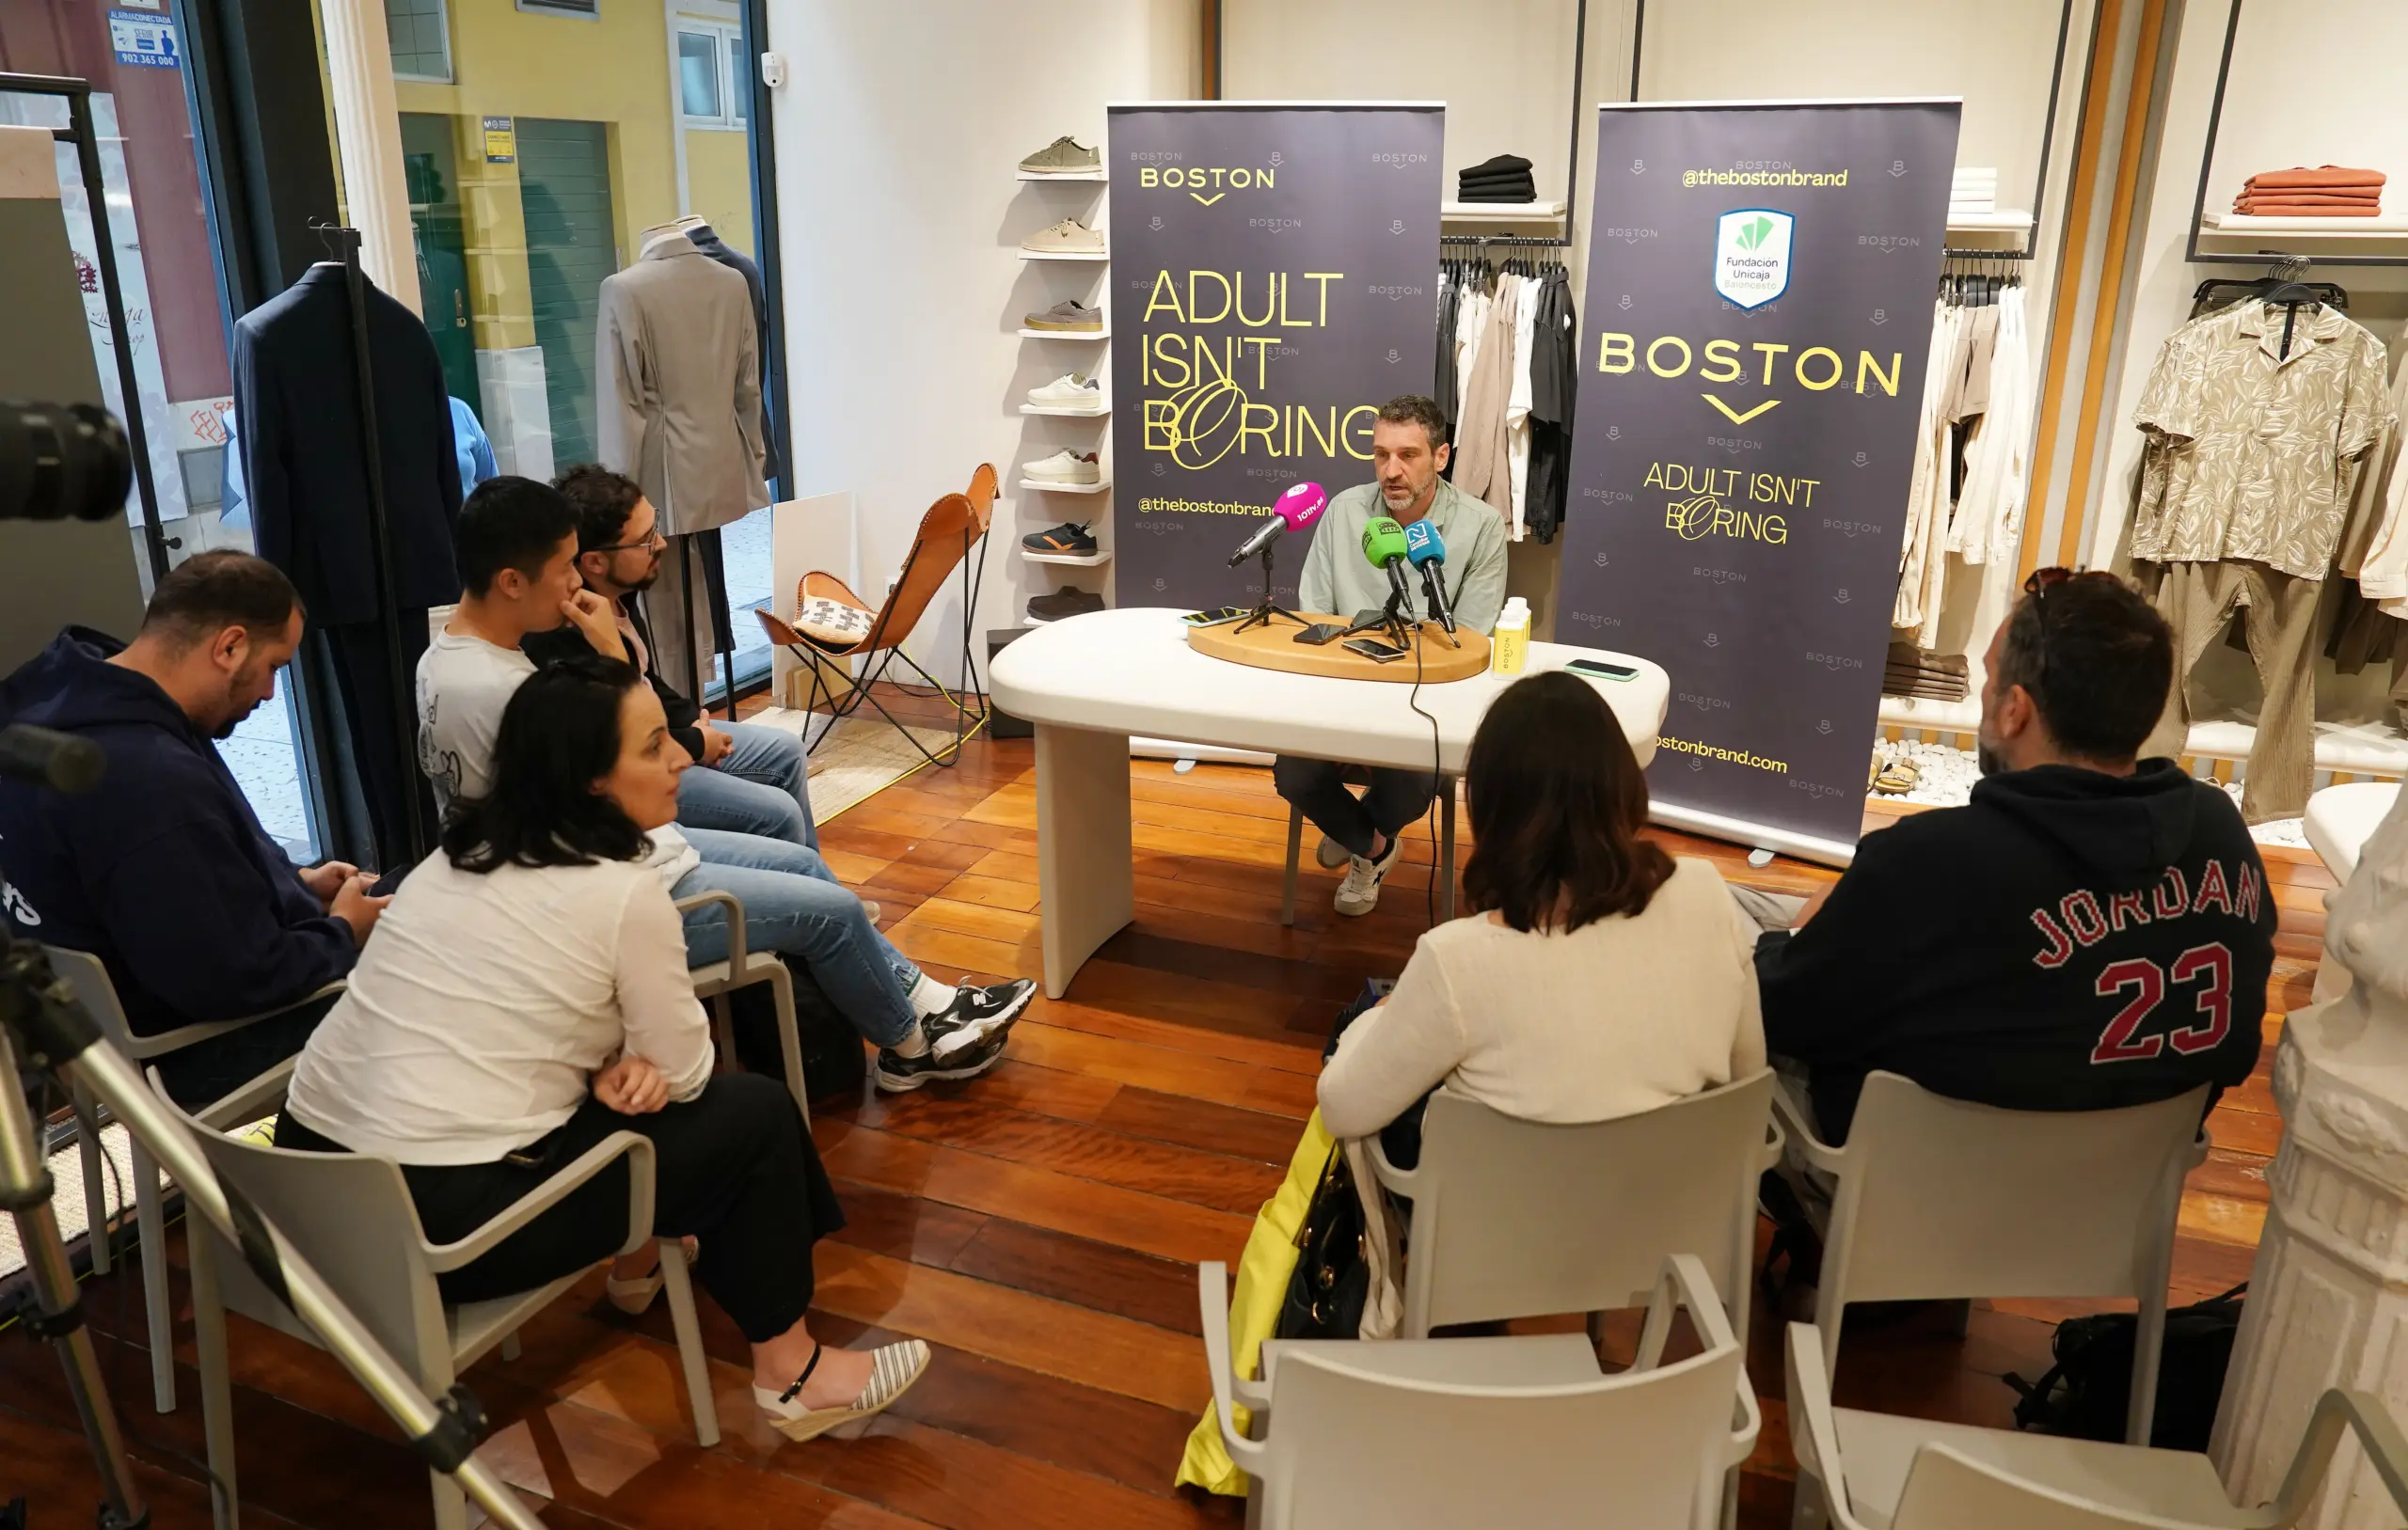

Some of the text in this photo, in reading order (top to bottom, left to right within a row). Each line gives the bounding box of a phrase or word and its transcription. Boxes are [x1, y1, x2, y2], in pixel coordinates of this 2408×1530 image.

[122, 53, 173, 66] 902 365 000
[1131, 152, 1182, 161] BOSTON
[1371, 153, 1428, 163] BOSTON
[1736, 160, 1791, 170] BOSTON
[1140, 167, 1275, 188] BOSTON
[1682, 169, 1847, 188] @thebostonbrand
[1249, 218, 1302, 228] BOSTON
[1858, 235, 1921, 246] BOSTON
[1727, 258, 1778, 267] Fundación
[1734, 270, 1770, 282] Unicaja
[1132, 280, 1183, 290] BOSN
[1369, 285, 1422, 295] BOSTON
[1143, 269, 1344, 327] ADULT
[1721, 301, 1778, 312] BOON
[1143, 333, 1281, 389] ISN'T
[1599, 332, 1902, 397] BOSTON
[1144, 380, 1380, 469] BORING
[1707, 436, 1762, 450] BOSTON
[1643, 463, 1821, 508] ADULT ISN'T
[1584, 488, 1633, 502] BOSTON
[1138, 497, 1275, 517] @thebostonbran
[1296, 497, 1323, 522] 101tv.es
[1666, 496, 1787, 544] BORING
[1823, 519, 1881, 534] BOSTON
[1693, 566, 1747, 583] BOSTON
[1246, 585, 1295, 594] BOTON
[1573, 611, 1622, 626] BOSTON
[1806, 653, 1862, 669] BOSTON
[1678, 693, 1731, 709] BOSTON
[1656, 735, 1787, 773] ostonbrand.com
[1789, 779, 1844, 797] BOSTON
[2030, 860, 2259, 969] JORDAN
[2090, 941, 2232, 1065] 23
